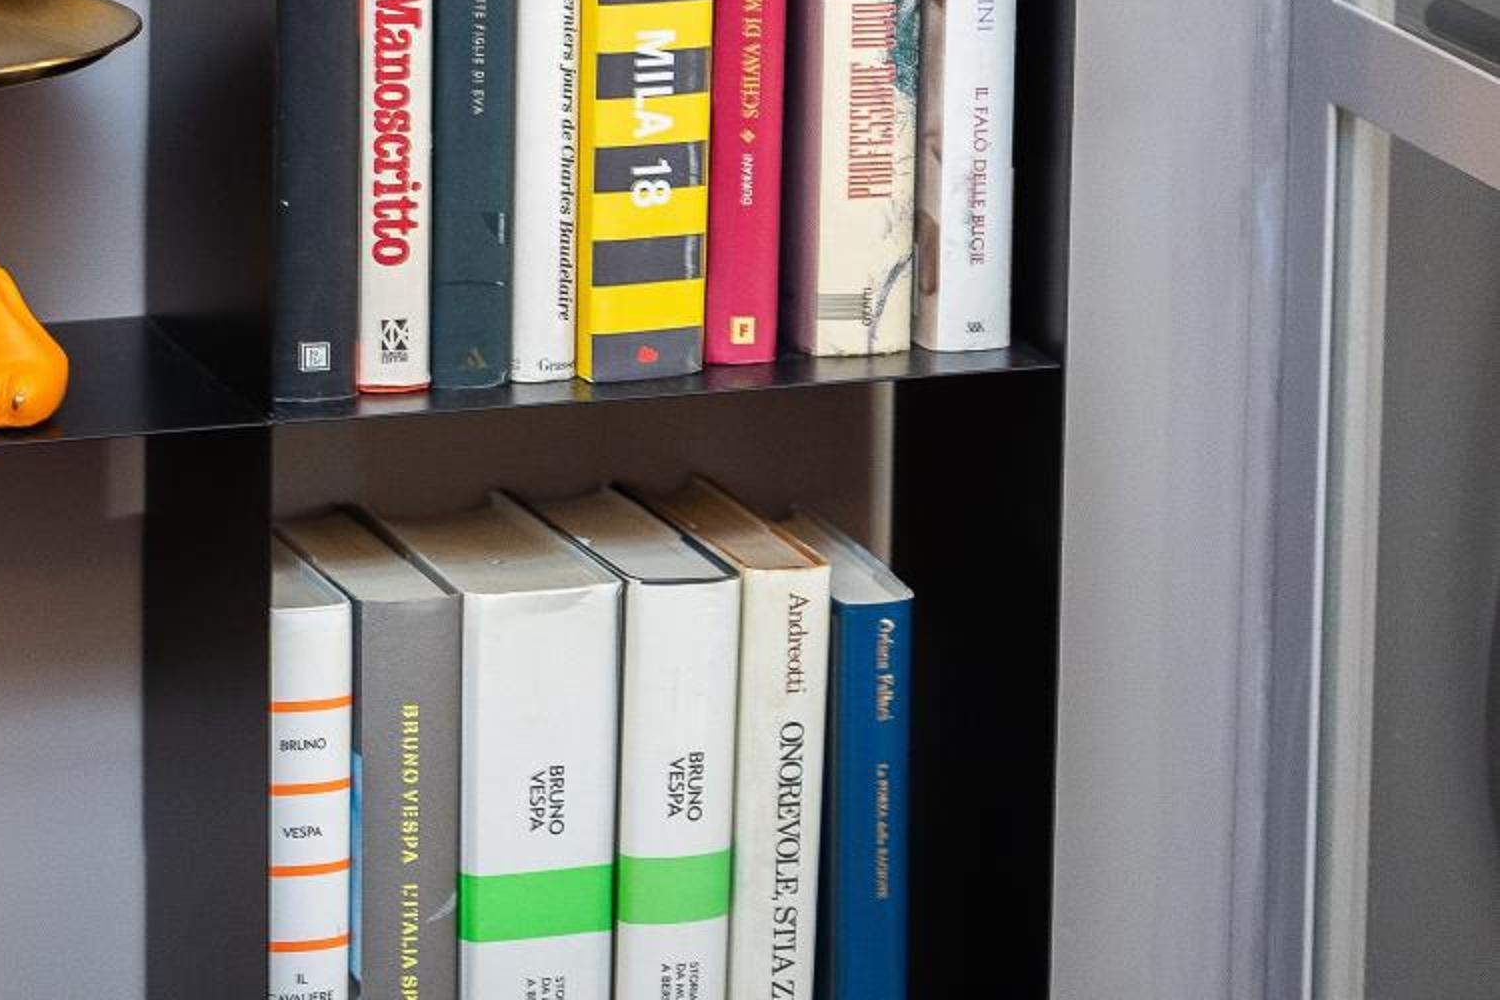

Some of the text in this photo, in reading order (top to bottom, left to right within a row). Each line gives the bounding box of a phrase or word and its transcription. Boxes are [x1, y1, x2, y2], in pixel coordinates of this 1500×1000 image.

[472, 22, 485, 65] FIGLIE
[743, 16, 762, 37] DI
[471, 89, 484, 116] EVA
[472, 70, 485, 83] DI
[558, 64, 575, 114] jours
[740, 42, 760, 119] SCHIAVA
[974, 87, 989, 101] IL
[559, 118, 575, 141] de
[629, 28, 677, 209] MILA 18
[558, 144, 575, 216] Charles
[970, 159, 986, 209] DELLE
[556, 219, 574, 322] Baudelaire
[969, 214, 985, 265] BUGIE
[785, 592, 810, 696] Andreotti
[279, 736, 327, 753] BRUNO
[401, 704, 420, 782] BRUNO
[529, 770, 547, 833] VESPA
[548, 765, 566, 836] BRUNO
[666, 758, 685, 819] VESPA
[687, 752, 705, 822] BRUNO
[772, 720, 805, 901] ONOREVOLE,
[282, 825, 324, 840] VESPA
[401, 789, 420, 865] VESPA
[400, 883, 419, 969] L'ITALIA
[771, 906, 799, 976] STIA
[296, 973, 309, 985] IL
